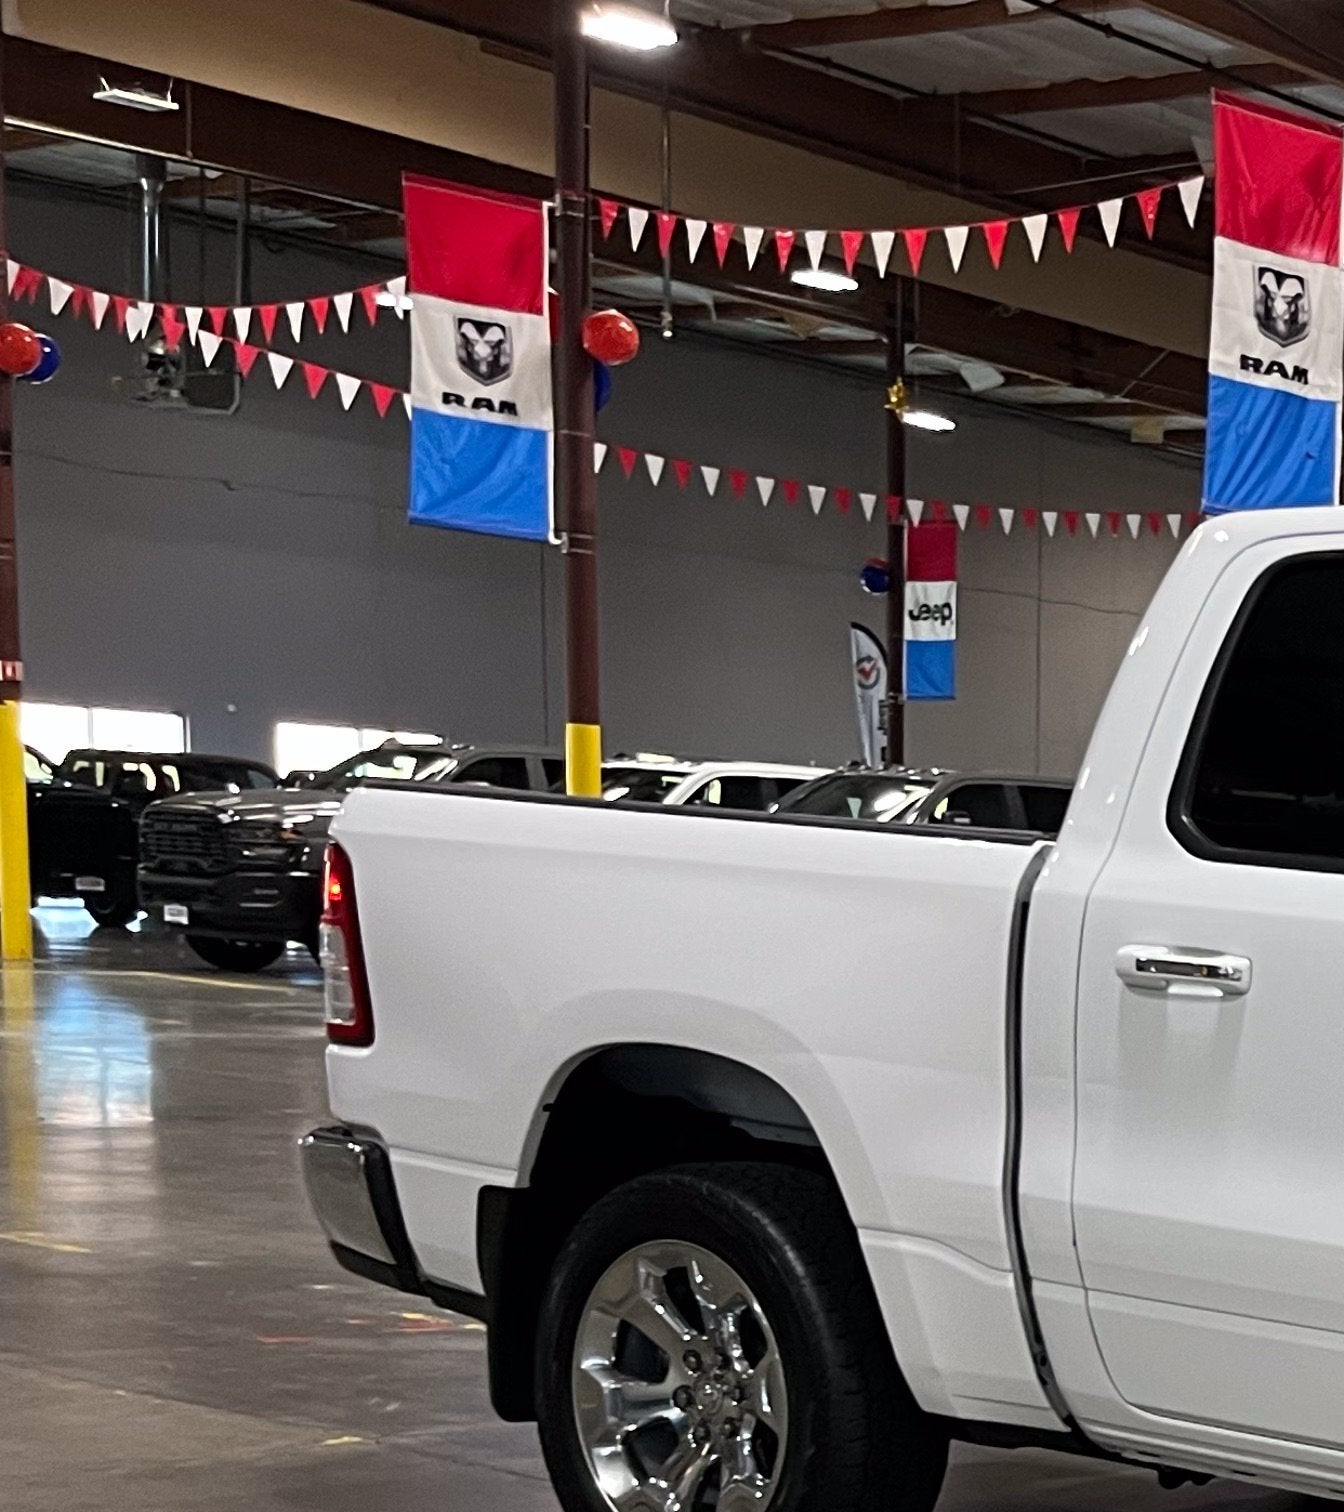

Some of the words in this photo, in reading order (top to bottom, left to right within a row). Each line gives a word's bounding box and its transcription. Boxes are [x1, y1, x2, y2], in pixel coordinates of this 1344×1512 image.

[1240, 354, 1309, 385] RAM
[442, 391, 519, 416] RAM
[908, 602, 953, 626] Jeep
